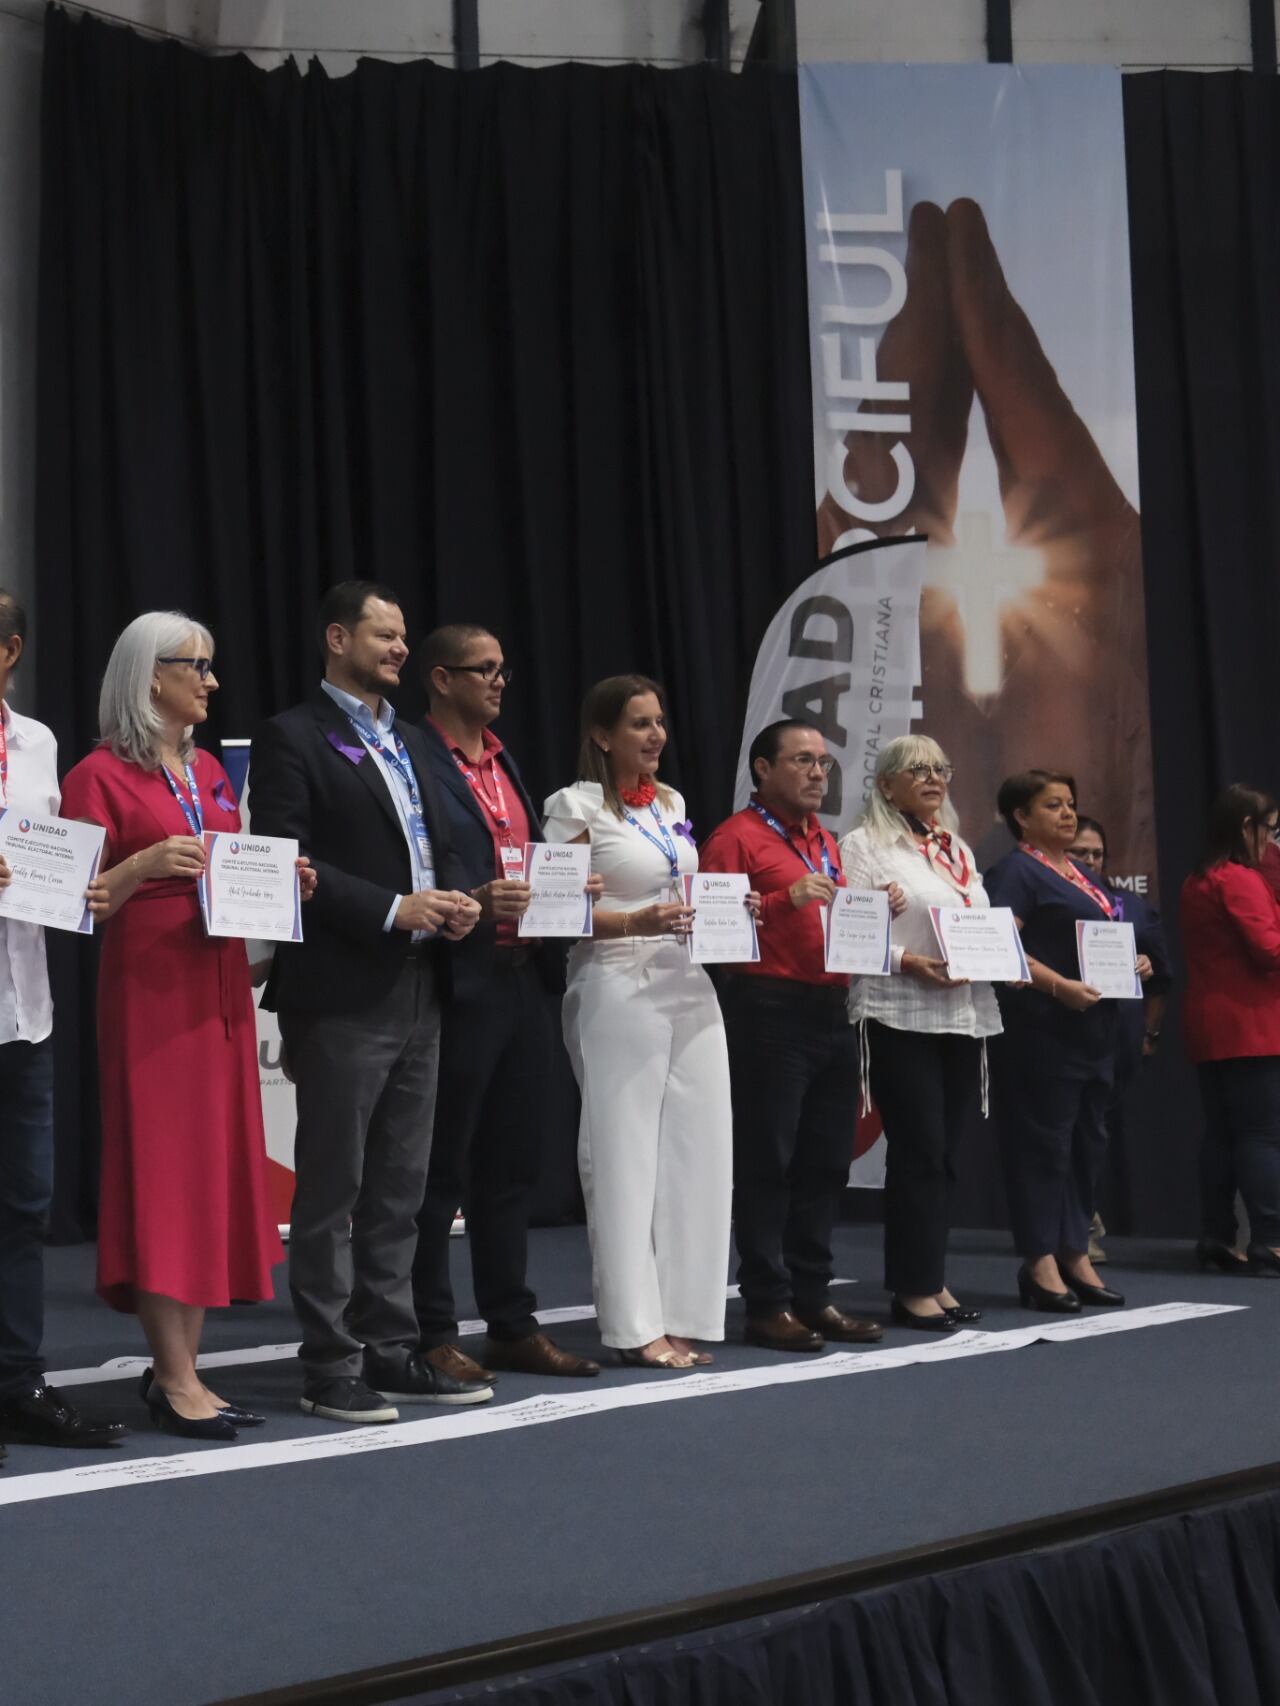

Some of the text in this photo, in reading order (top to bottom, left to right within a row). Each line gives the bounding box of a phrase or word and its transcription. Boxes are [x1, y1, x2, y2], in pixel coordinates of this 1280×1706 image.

[816, 169, 915, 552] CIFUL
[869, 596, 892, 714] CRISTIANA
[32, 823, 67, 837] UNIDAD
[241, 843, 271, 853] UNIDAD
